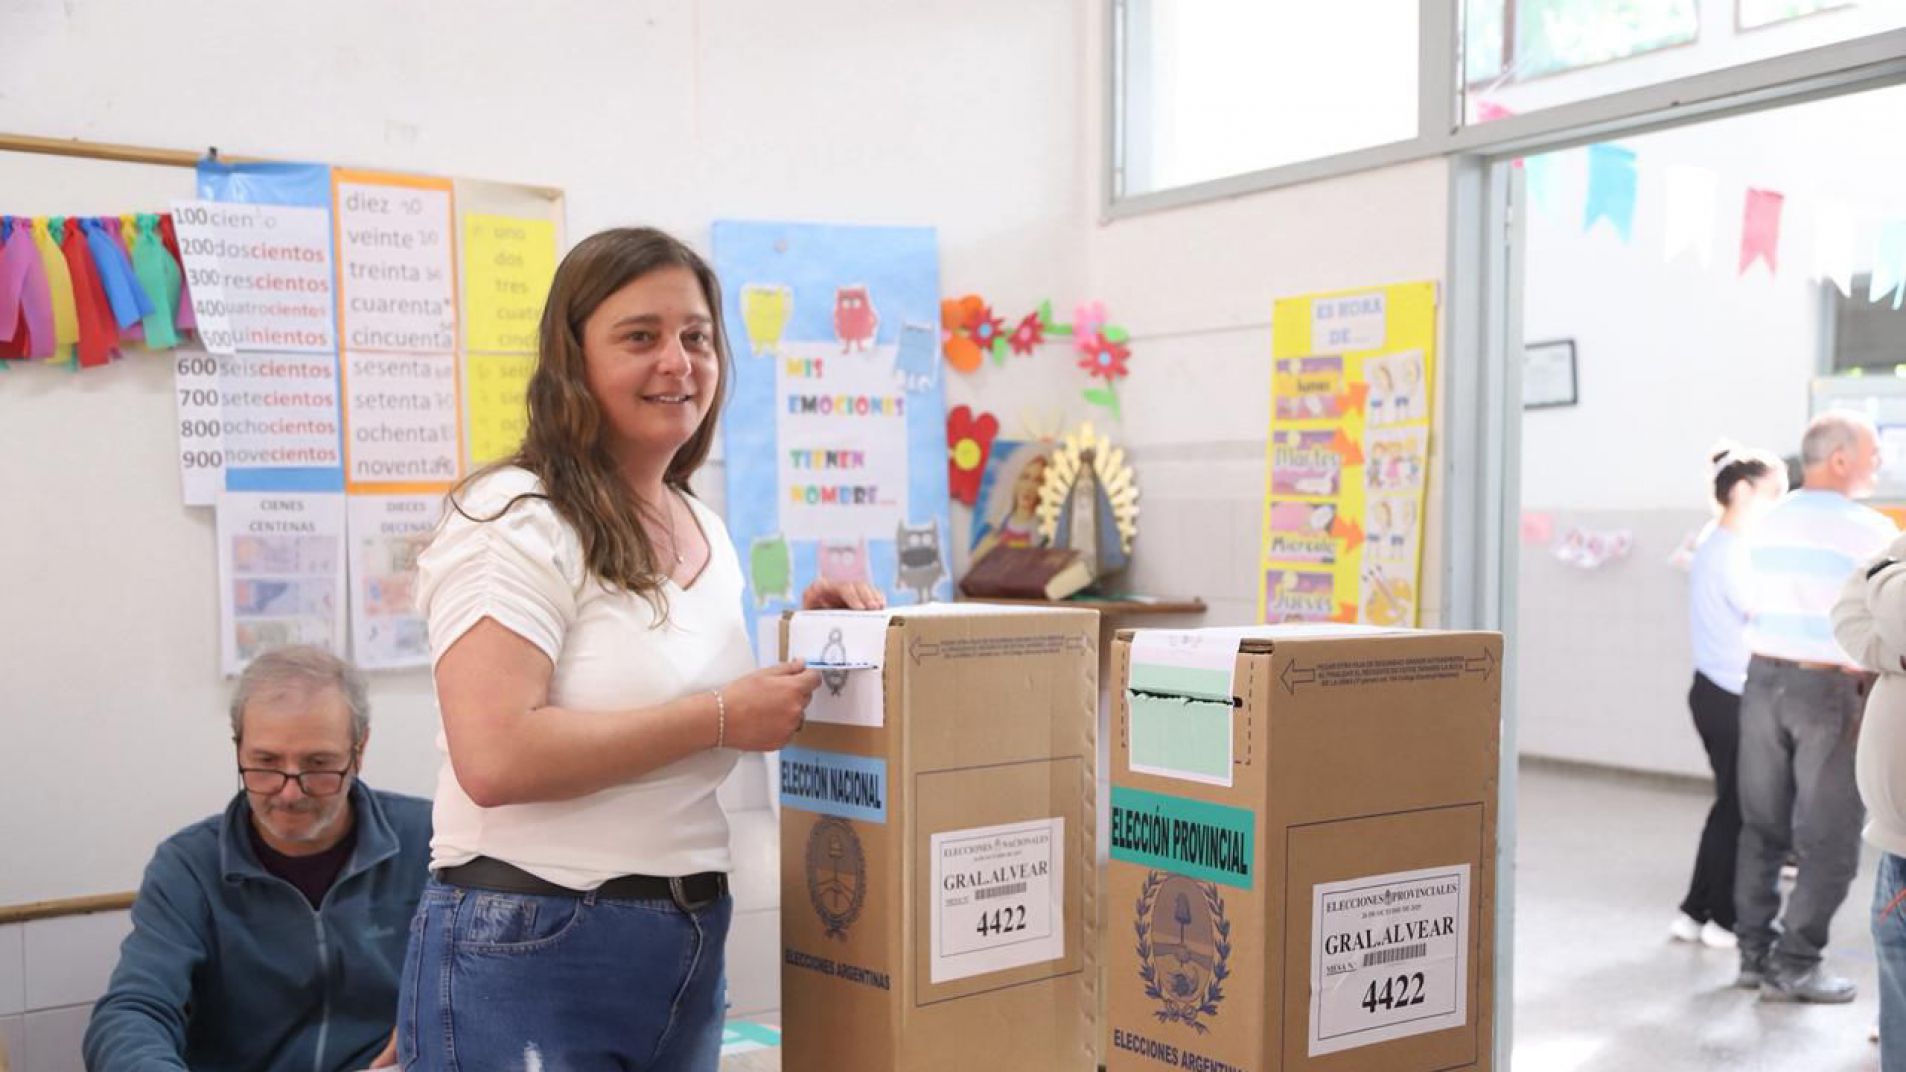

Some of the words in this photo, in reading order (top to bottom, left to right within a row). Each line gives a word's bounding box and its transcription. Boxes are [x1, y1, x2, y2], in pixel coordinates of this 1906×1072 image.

[346, 192, 388, 214] diez
[176, 208, 206, 226] 100
[347, 229, 413, 249] veinte
[182, 239, 214, 256] 200
[216, 241, 324, 262] doscientos
[189, 269, 219, 286] 300
[224, 275, 329, 293] rescientos
[349, 263, 419, 281] treinta
[226, 303, 326, 318] uatrocientos
[350, 297, 442, 315] cuarenta
[353, 327, 451, 347] cincuenta
[178, 358, 216, 375] 600
[220, 361, 332, 378] seiscientos
[354, 359, 430, 379] sesenta
[787, 358, 823, 378] MIS
[180, 389, 218, 406] 700
[221, 392, 333, 409] setecientos
[355, 392, 430, 411] setenta
[789, 395, 904, 415] EMOCIONES
[182, 420, 220, 437] 800
[222, 420, 336, 437] ochocientos
[357, 423, 441, 442] ochenta
[183, 451, 222, 468] 900
[224, 448, 337, 465] novecientos
[358, 458, 442, 476] noventa
[790, 450, 864, 468] TIENEN
[260, 501, 303, 511] CIENES
[387, 502, 426, 512] DIECES
[249, 521, 315, 533] CENTENAS
[782, 758, 829, 801] ELECCIÓN
[830, 767, 882, 809] NACIONAL
[1112, 804, 1170, 859] ELECCIÓN
[1173, 819, 1248, 875] PROVINCIAL
[1327, 893, 1385, 912] ELECCIONES
[1392, 883, 1458, 902] PROVINCIALES
[977, 905, 1026, 936] 4422
[785, 948, 835, 976] ELECCIONES
[836, 963, 890, 991] ARGENTINAS
[1361, 972, 1426, 1013] 4422
[1114, 1029, 1178, 1066] ELECCIONES
